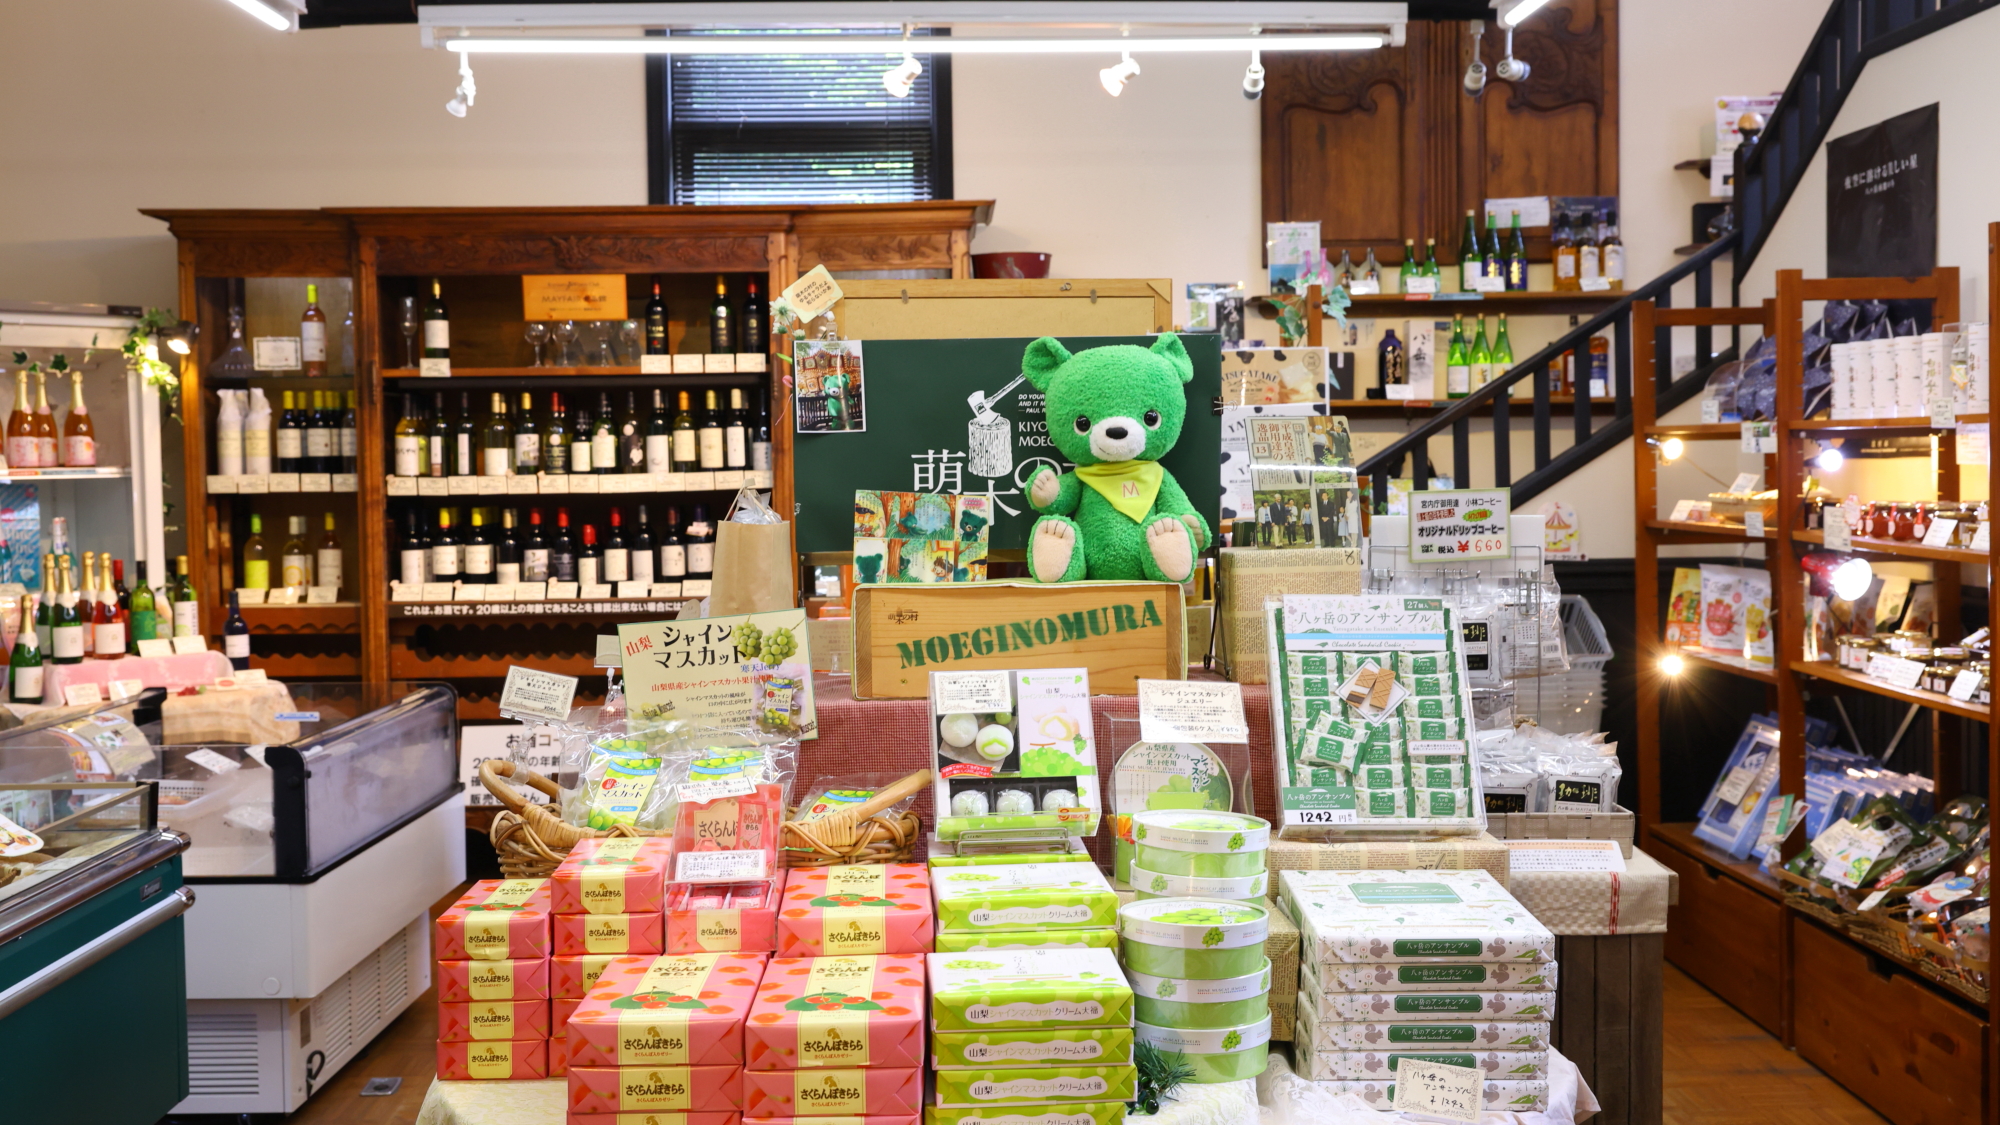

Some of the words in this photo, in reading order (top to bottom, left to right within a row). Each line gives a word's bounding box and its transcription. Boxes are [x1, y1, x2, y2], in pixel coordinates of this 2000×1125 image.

[1018, 421, 1048, 433] KIYO
[1018, 435, 1055, 447] MOEG
[1255, 446, 1267, 454] 13
[1122, 480, 1140, 498] M
[1421, 499, 1460, 509] 宮内庁御用達
[1465, 497, 1502, 507] 小林コーヒー
[1418, 524, 1505, 537] オリジナルドリップコーヒー
[1437, 545, 1455, 554] 税込
[1475, 539, 1502, 553] 660
[1406, 600, 1429, 609] 27個入
[1297, 611, 1432, 625] 八ヶ岳のアンサンブル
[662, 624, 732, 648] シャイン
[896, 599, 1163, 669] MOEGINOMURA
[625, 635, 653, 657] 山梨
[653, 645, 748, 669] マスカット
[651, 674, 774, 692] 山梨県産シャインマスカット果汁使用
[686, 692, 746, 702] シャインマスカットの風味が
[708, 699, 753, 707] 口の中に広がります
[1146, 744, 1177, 752] 山梨県産
[1132, 751, 1192, 760] シャインマスカット
[1200, 755, 1211, 786] シャイン
[613, 782, 649, 791] シャイン
[602, 790, 643, 799] マスカット
[1287, 793, 1352, 801] 八ヶ岳のアンサンブル
[1300, 811, 1333, 823] 1242
[1338, 814, 1347, 823] 円
[584, 890, 622, 898] さくらんぼきらら
[973, 909, 1088, 922] 山梨シャインマスカットクリーム大福
[588, 929, 626, 938] さくらんぼきらら
[700, 928, 738, 936] さくらんぼきらら
[828, 931, 881, 943] さくらんぼきらら
[468, 935, 506, 944] さくらんぼきらら
[472, 975, 511, 983] さくらんぼきらら
[970, 1006, 1099, 1019] 山梨シャインマスカットクリーム大福
[473, 1015, 511, 1023] さくらんぼきらら
[623, 1038, 683, 1050] さくらんぼきらら
[803, 1040, 863, 1052] さくらんぼきらら
[969, 1045, 1098, 1058] 山梨シャインマスカットクリーム大福
[471, 1054, 509, 1063] さくらんぼきらら
[625, 1084, 685, 1096] さくらんぼきらら
[800, 1088, 860, 1100] さくらんぼきらら
[974, 1082, 1102, 1095] 山梨シャインマスカットクリーム大福
